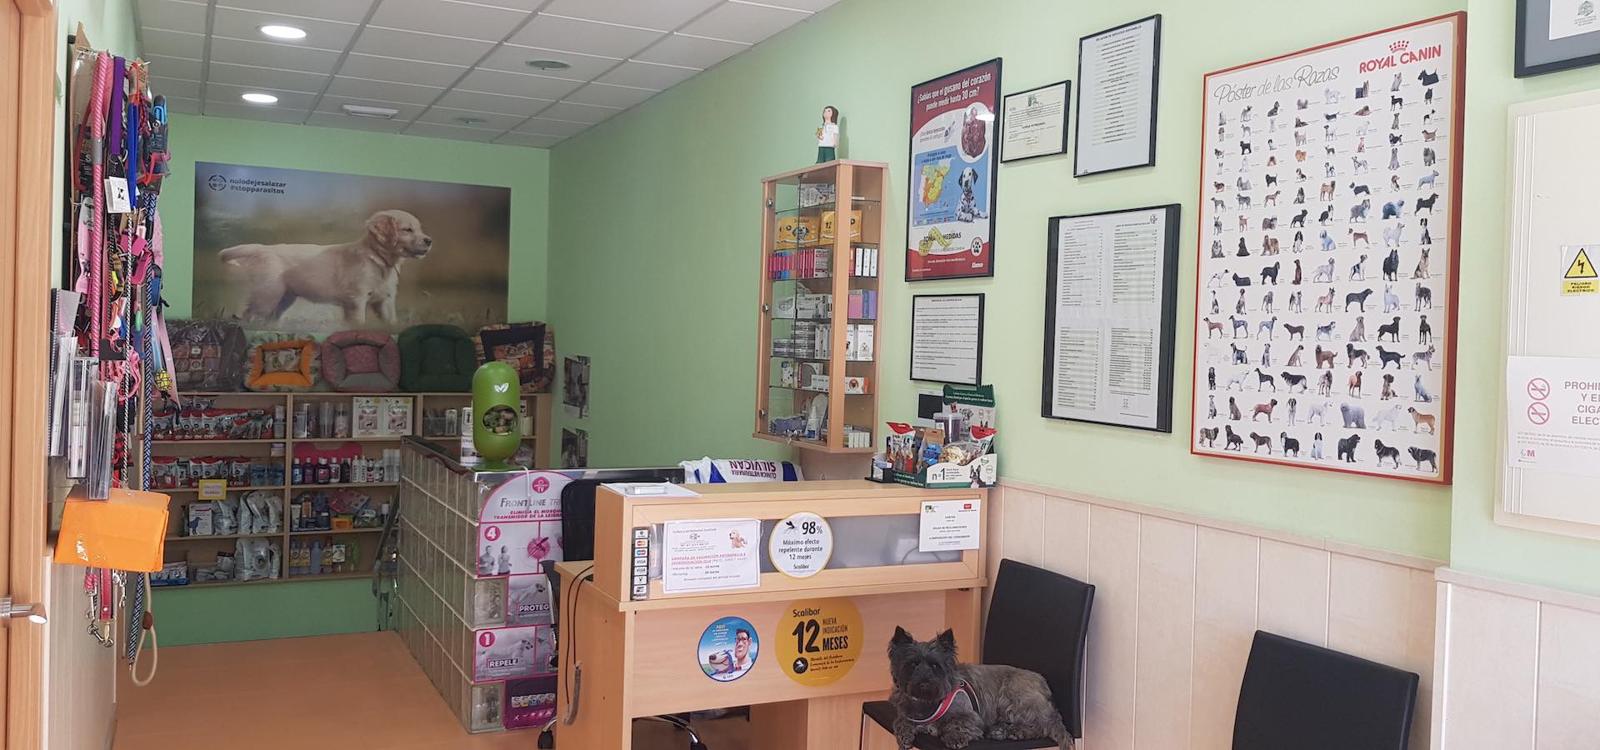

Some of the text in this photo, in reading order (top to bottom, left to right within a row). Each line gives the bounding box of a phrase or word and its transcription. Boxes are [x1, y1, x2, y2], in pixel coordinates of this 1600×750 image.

[1359, 44, 1442, 74] ROYAL CANIN
[961, 78, 970, 89] del
[1214, 63, 1340, 105] Póster de las Razas
[962, 89, 969, 100] 30
[1581, 393, 1587, 402] Y
[729, 460, 776, 473] SILVICAN
[486, 527, 497, 539] 4
[802, 521, 823, 535] 98%
[782, 537, 820, 546] Máximo efecto
[778, 546, 803, 554] repelente
[792, 607, 820, 618] Scalibor
[792, 619, 820, 654] 12
[822, 635, 848, 651] MESES
[489, 659, 518, 668] REPELE
